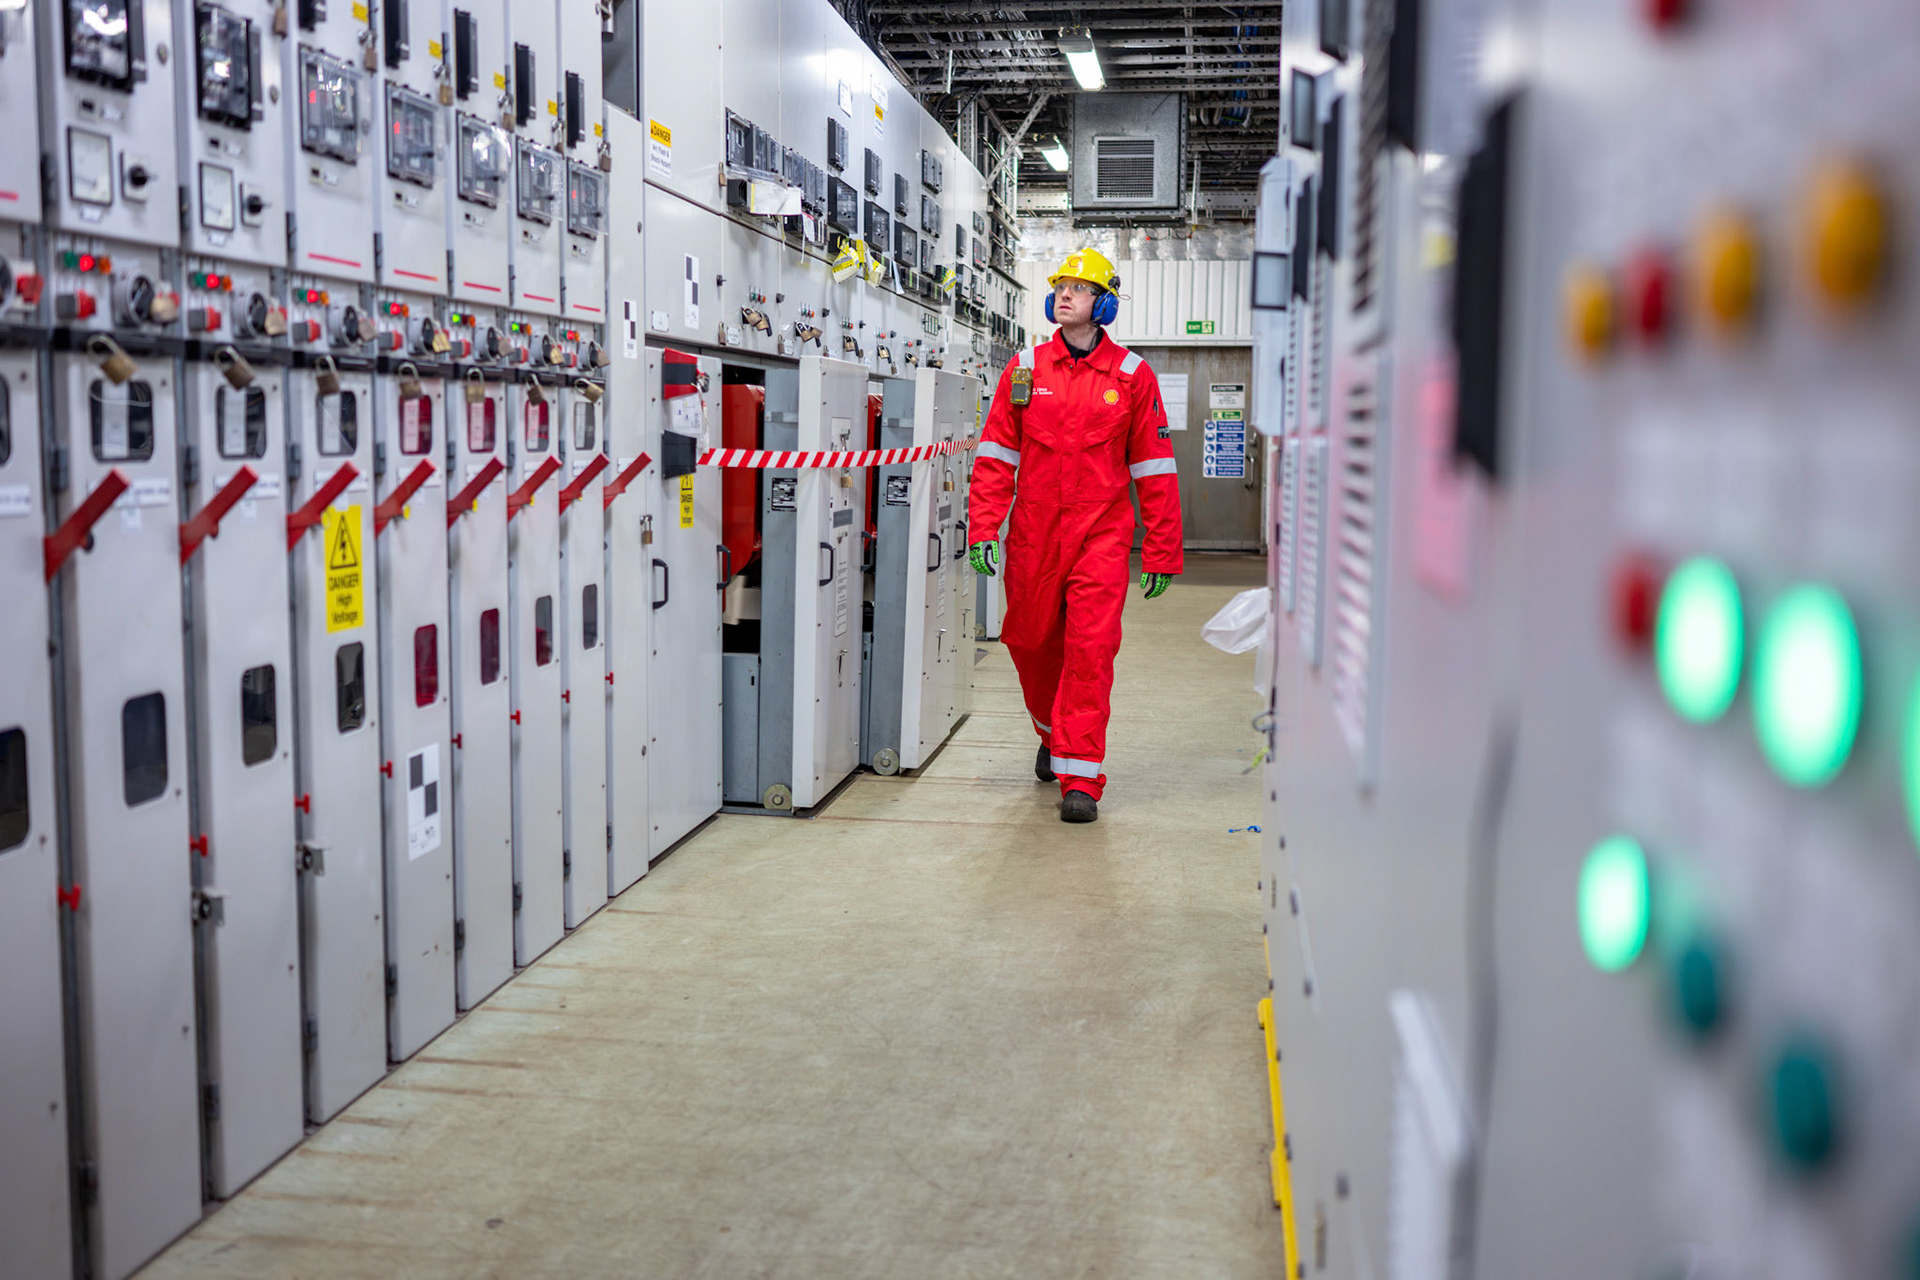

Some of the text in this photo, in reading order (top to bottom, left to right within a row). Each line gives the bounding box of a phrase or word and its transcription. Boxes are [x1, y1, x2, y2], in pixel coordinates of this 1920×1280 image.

[654, 126, 671, 142] DANGER
[681, 494, 692, 503] DANGER
[329, 573, 359, 591] DANGER
[336, 593, 352, 609] High
[332, 611, 358, 625] Voltage
